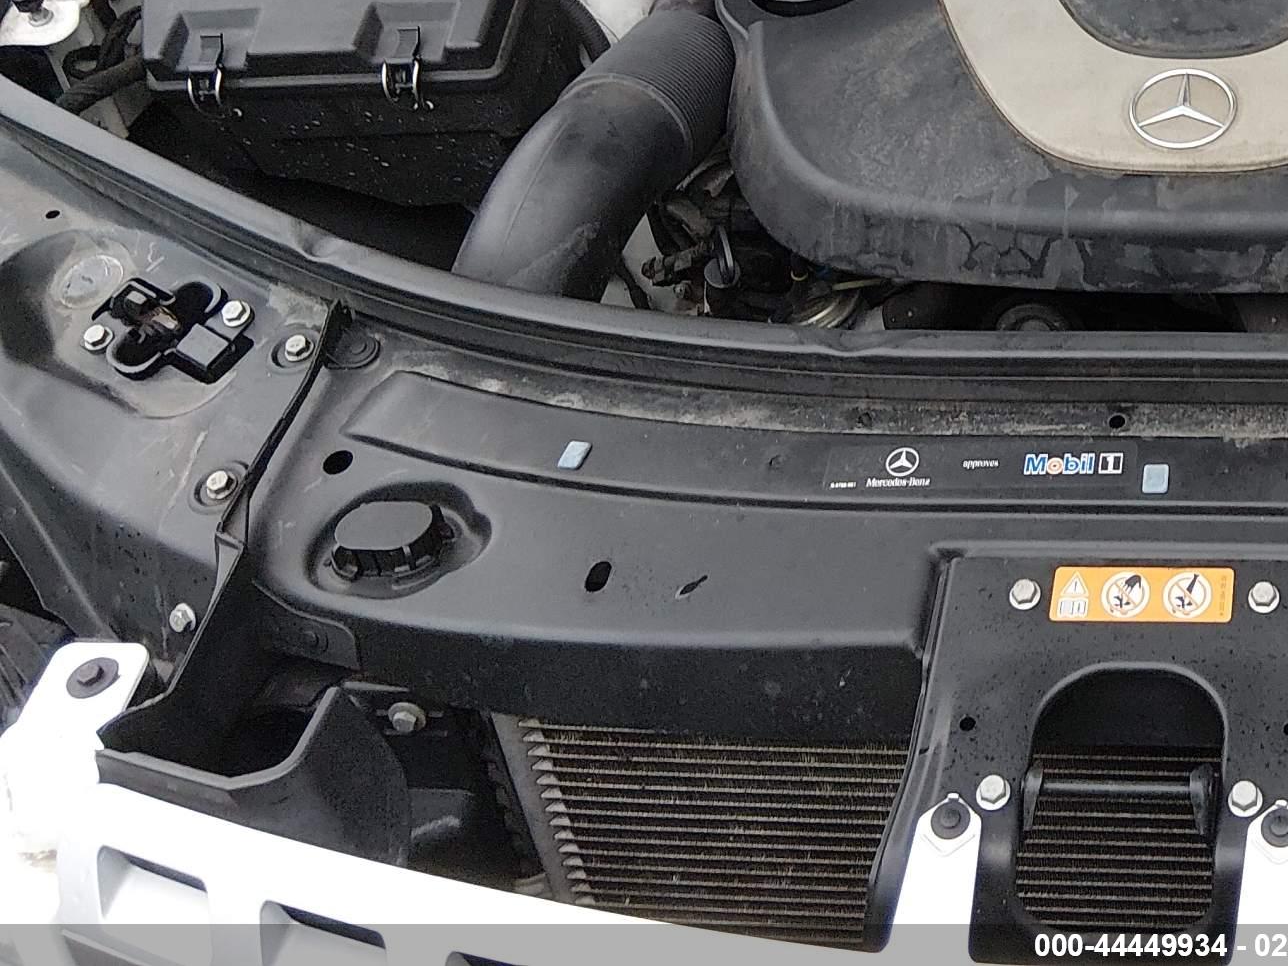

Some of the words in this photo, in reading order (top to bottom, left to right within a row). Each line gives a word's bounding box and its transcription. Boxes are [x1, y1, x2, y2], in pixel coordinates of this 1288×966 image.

[1024, 453, 1096, 475] Mobil
[1103, 454, 1120, 473] 1
[866, 477, 930, 488] Mercedes-Benz
